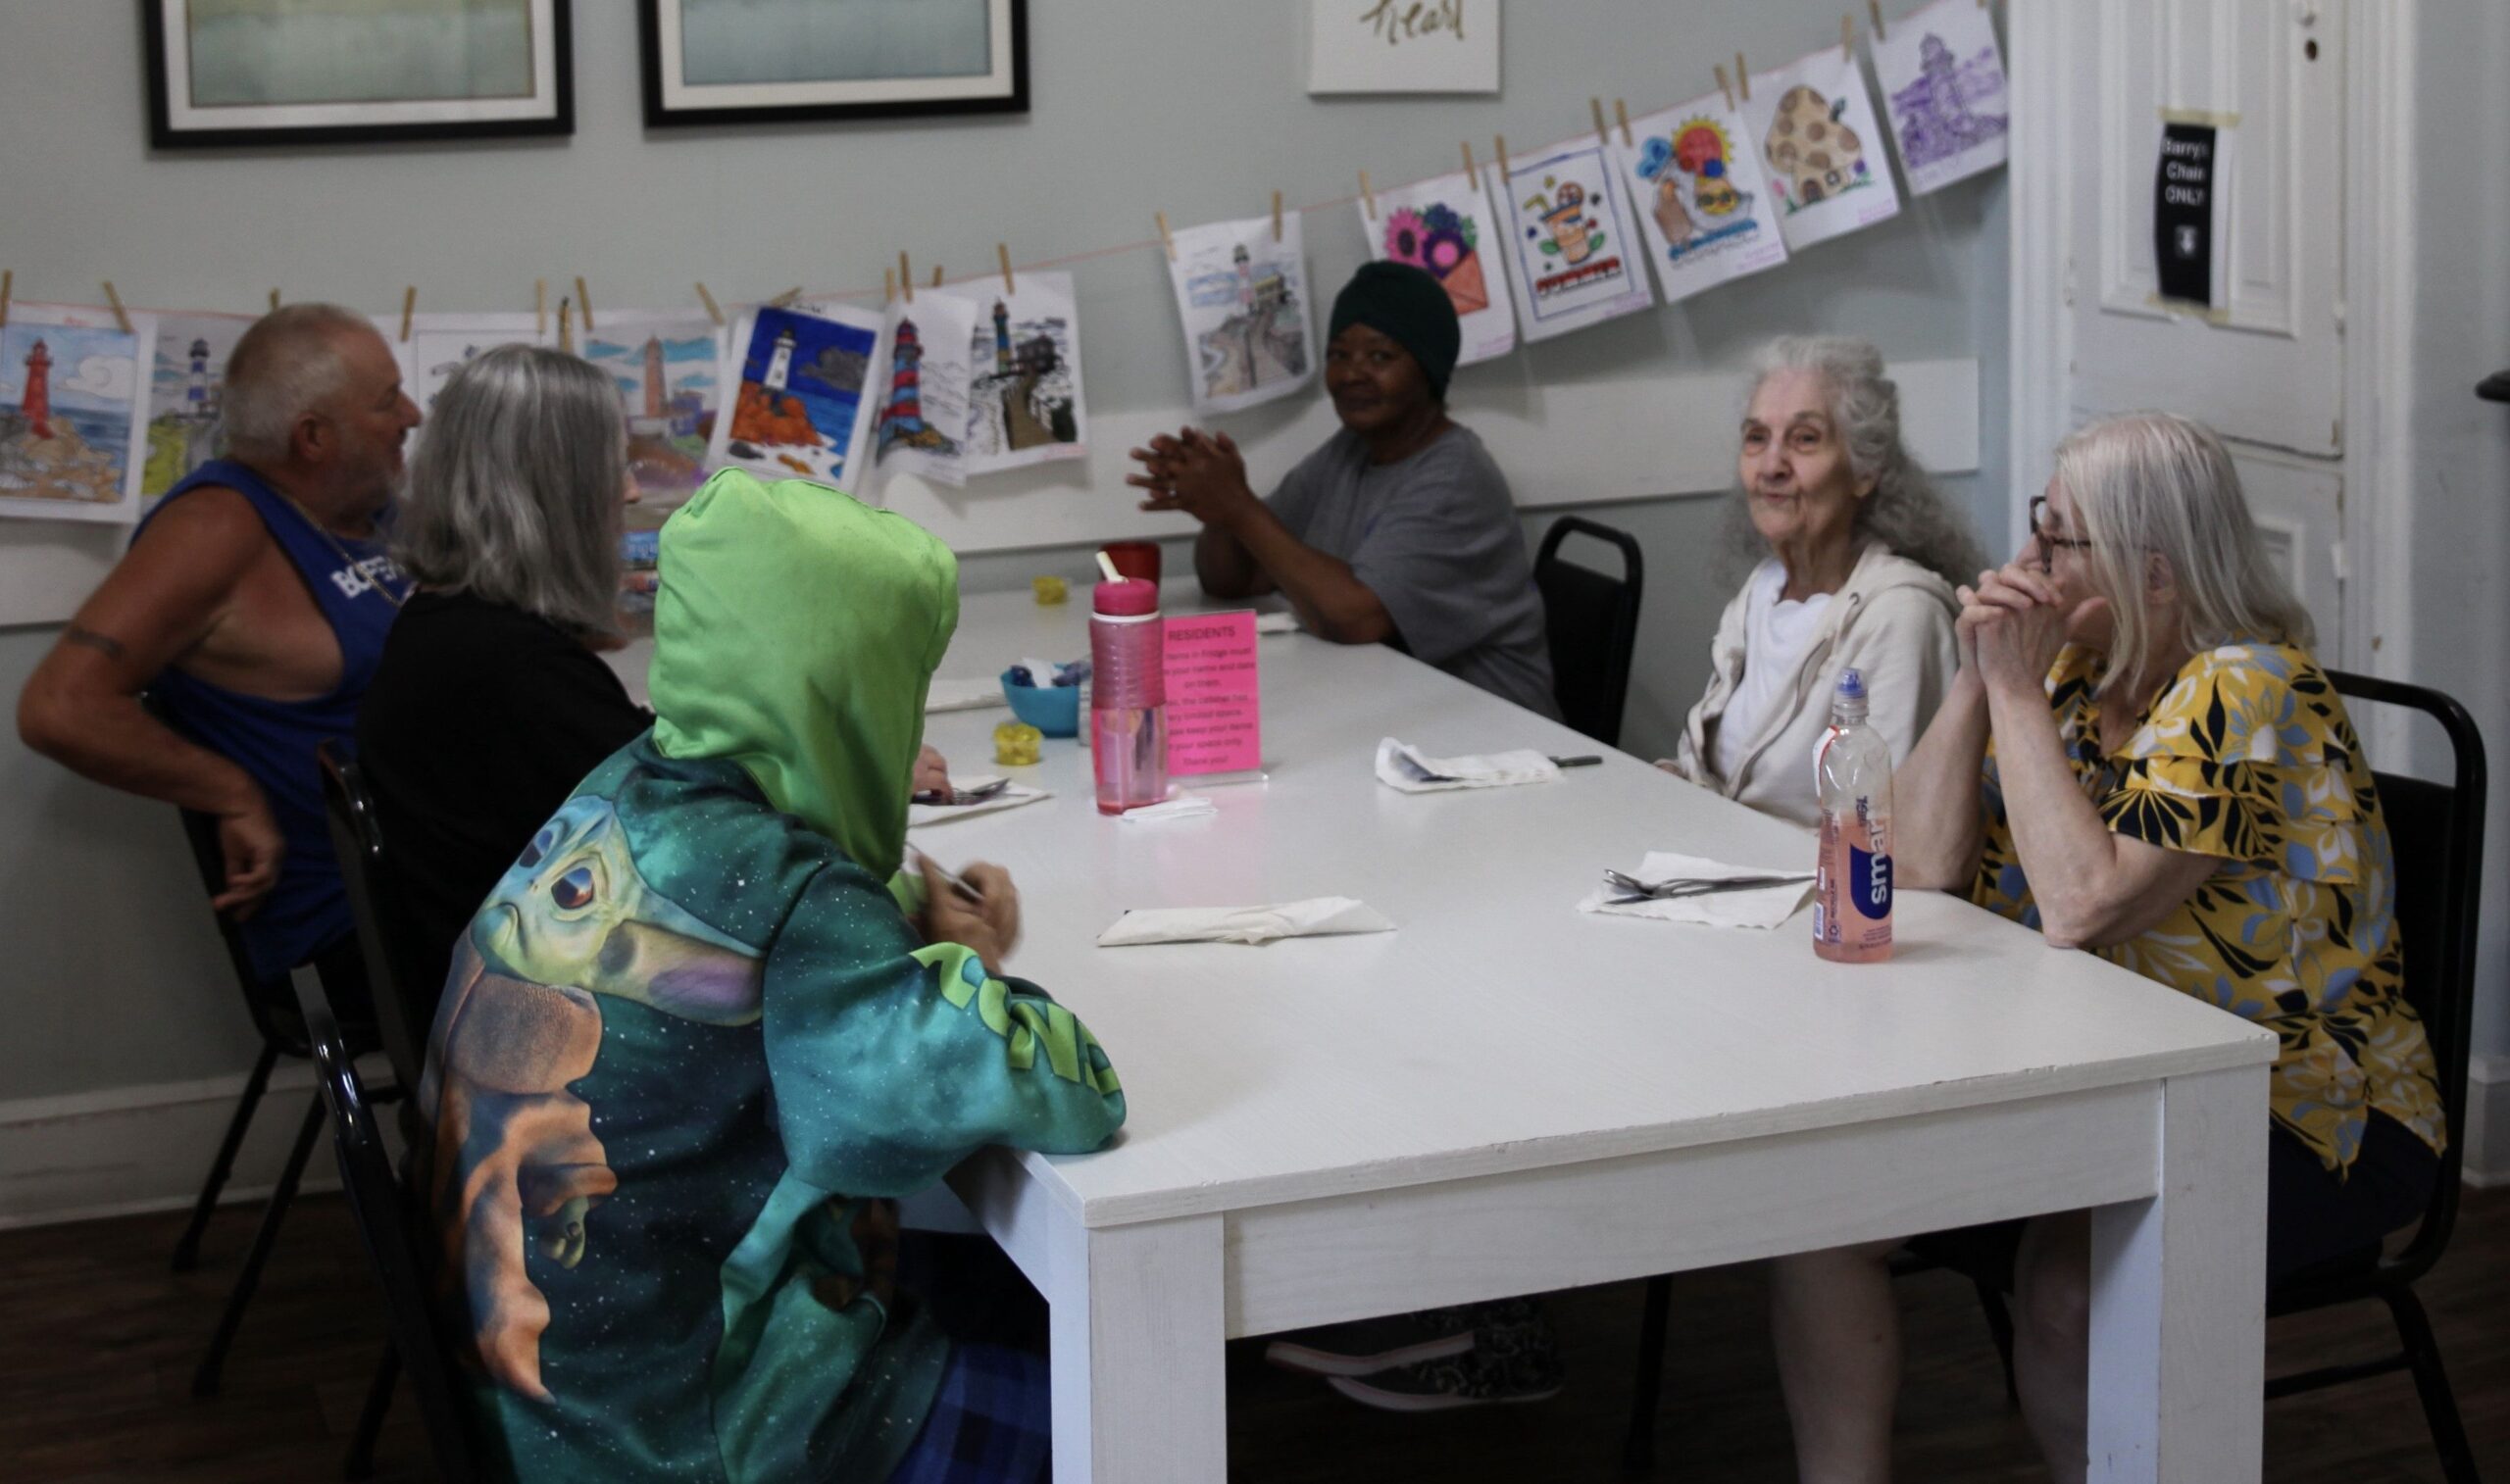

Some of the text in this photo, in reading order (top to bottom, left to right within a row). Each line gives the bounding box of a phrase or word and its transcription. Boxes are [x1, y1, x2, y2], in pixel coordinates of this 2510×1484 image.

[2166, 160, 2204, 180] Chair
[2165, 184, 2204, 205] ONLY
[1168, 625, 1235, 640] RESIDENTS
